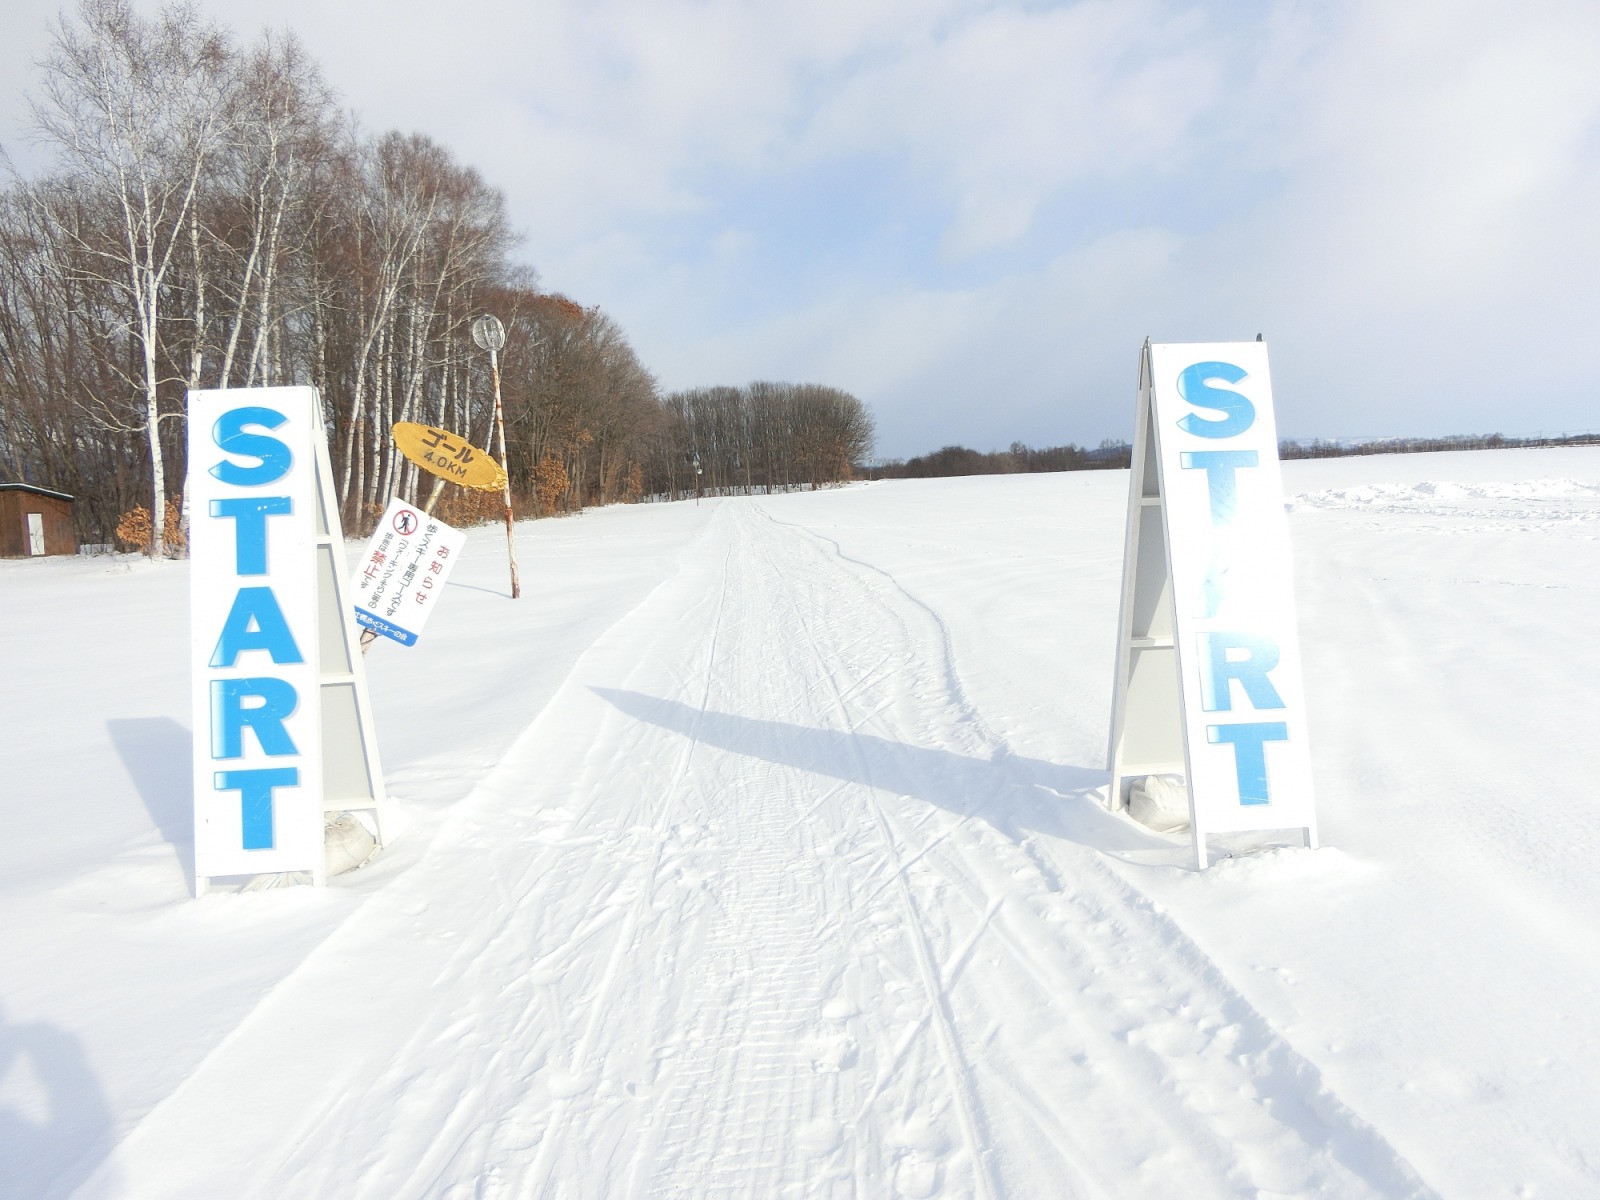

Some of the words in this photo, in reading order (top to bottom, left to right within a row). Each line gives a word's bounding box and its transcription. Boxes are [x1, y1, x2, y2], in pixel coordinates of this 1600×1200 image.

[422, 429, 474, 463] ゴール
[423, 451, 468, 478] 4.0KM
[415, 545, 450, 605] お知らせ
[207, 406, 304, 851] START
